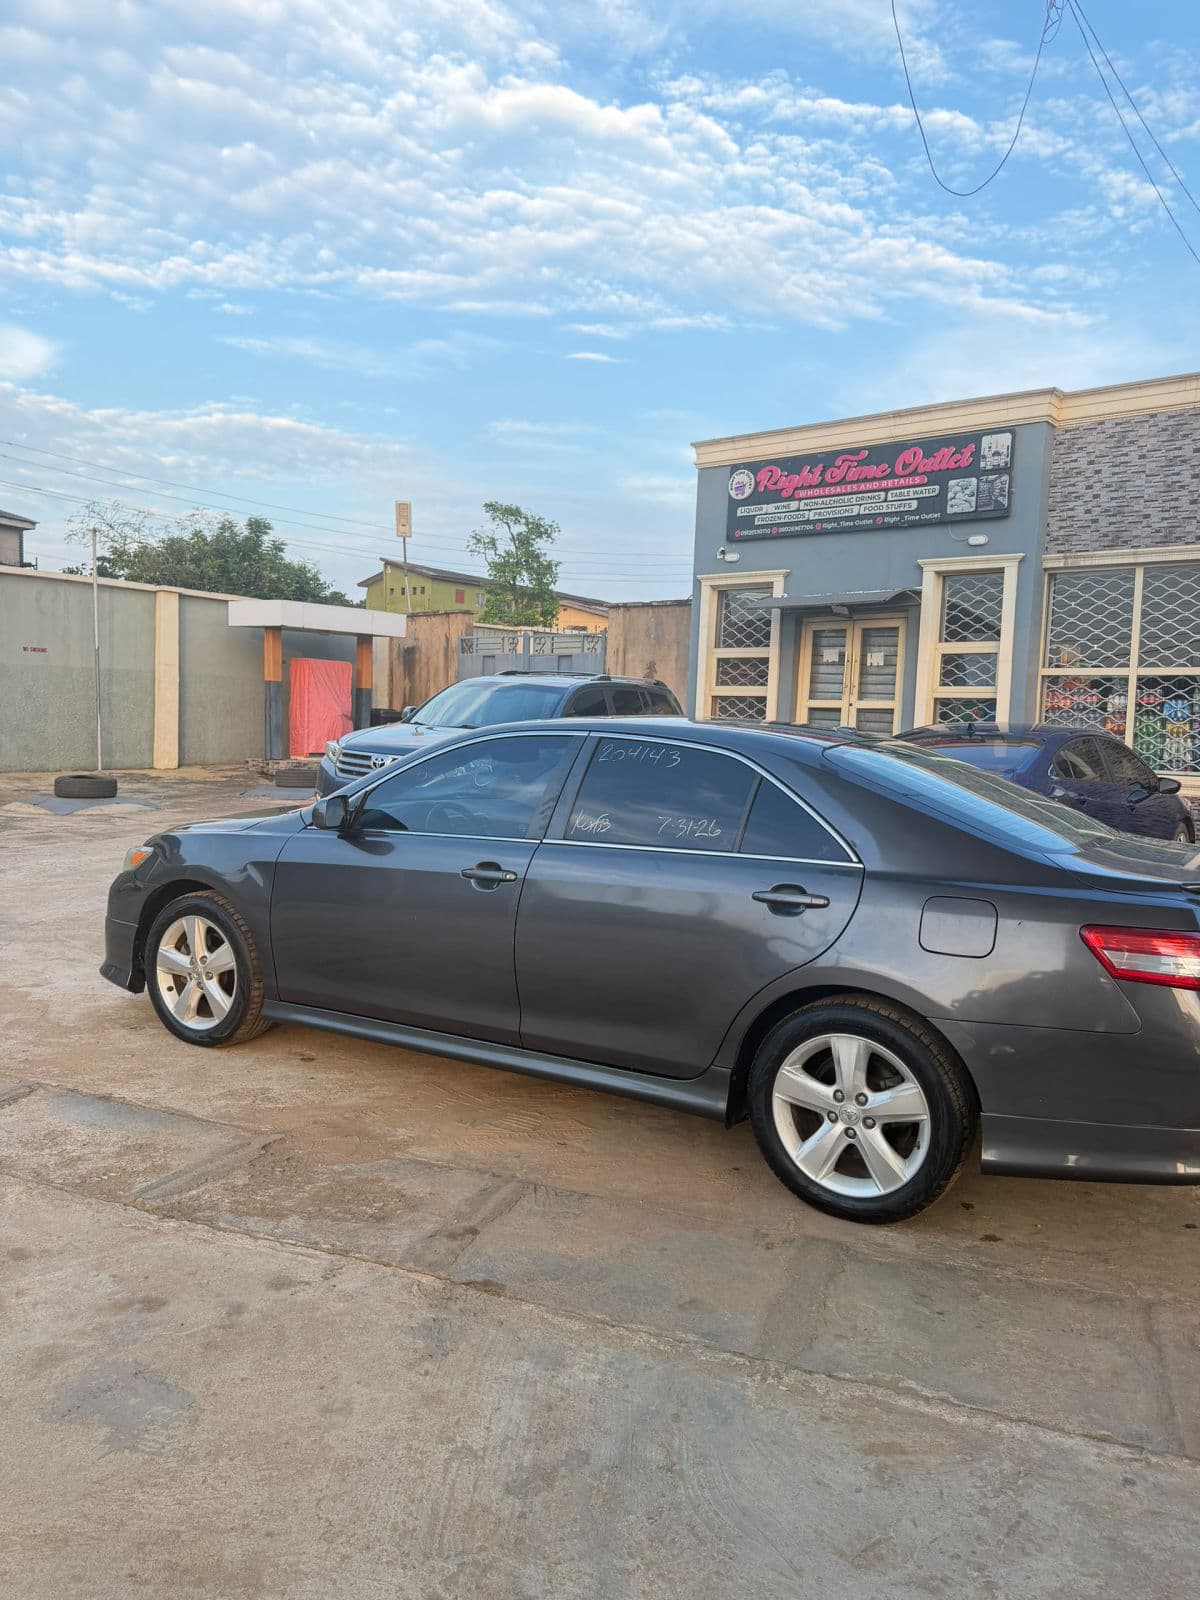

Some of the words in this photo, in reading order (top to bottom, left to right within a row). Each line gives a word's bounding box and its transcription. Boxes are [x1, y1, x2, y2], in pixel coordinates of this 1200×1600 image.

[756, 465, 824, 498] Right
[825, 450, 890, 482] Time
[895, 443, 976, 476] Outlet
[799, 484, 858, 498] WHOLESALES
[860, 482, 879, 491] AND
[881, 477, 921, 488] RETAILS
[891, 490, 911, 499] TABLE
[912, 487, 937, 497] WATER
[855, 493, 882, 503] DRINKS
[740, 506, 764, 515] LIQUOR
[774, 503, 791, 511] WINE
[813, 507, 855, 518] PROVISIONS
[863, 504, 884, 513] FOOD
[885, 502, 913, 511] STUFFS
[921, 512, 941, 520] Outlet
[855, 518, 874, 526] Outlet
[599, 744, 681, 768] 204143
